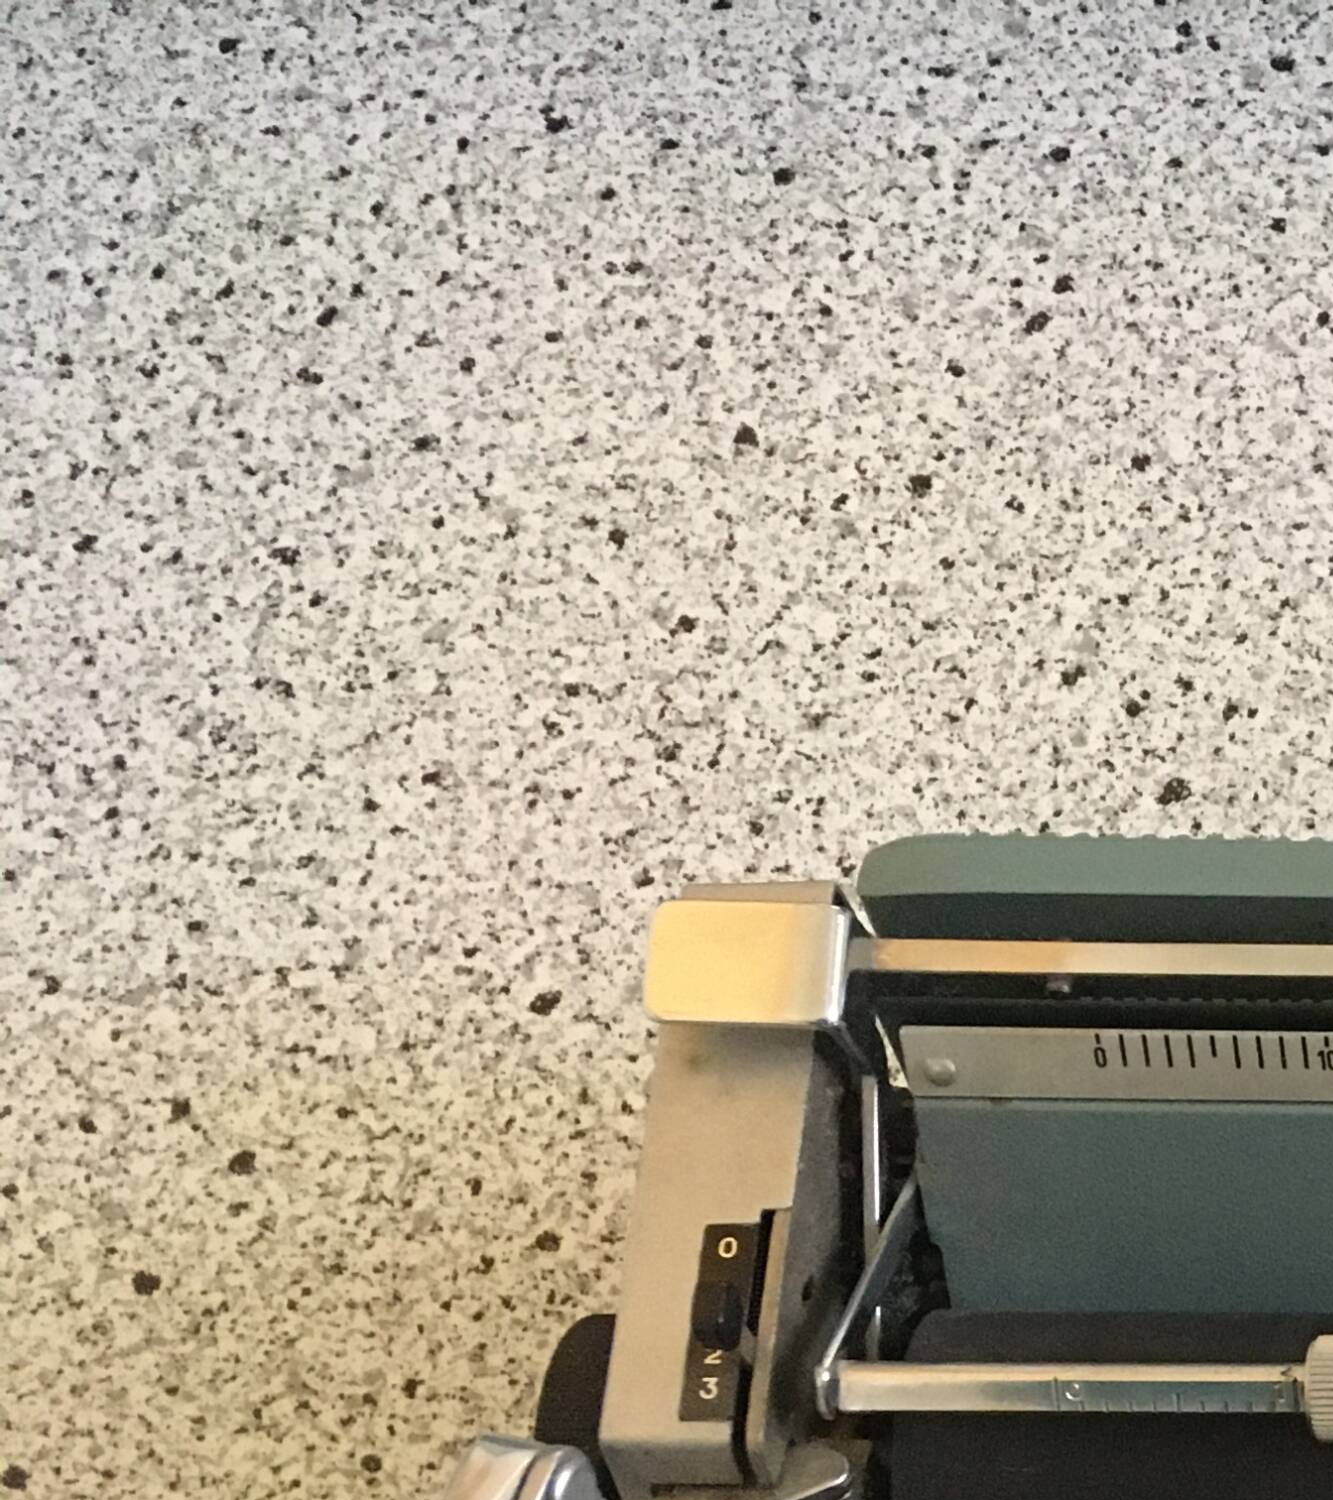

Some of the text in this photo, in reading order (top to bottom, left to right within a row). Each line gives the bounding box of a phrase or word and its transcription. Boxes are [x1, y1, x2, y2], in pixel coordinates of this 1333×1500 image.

[1093, 1046, 1107, 1068] 0
[718, 1236, 738, 1258] 0
[699, 1377, 719, 1400] 3
